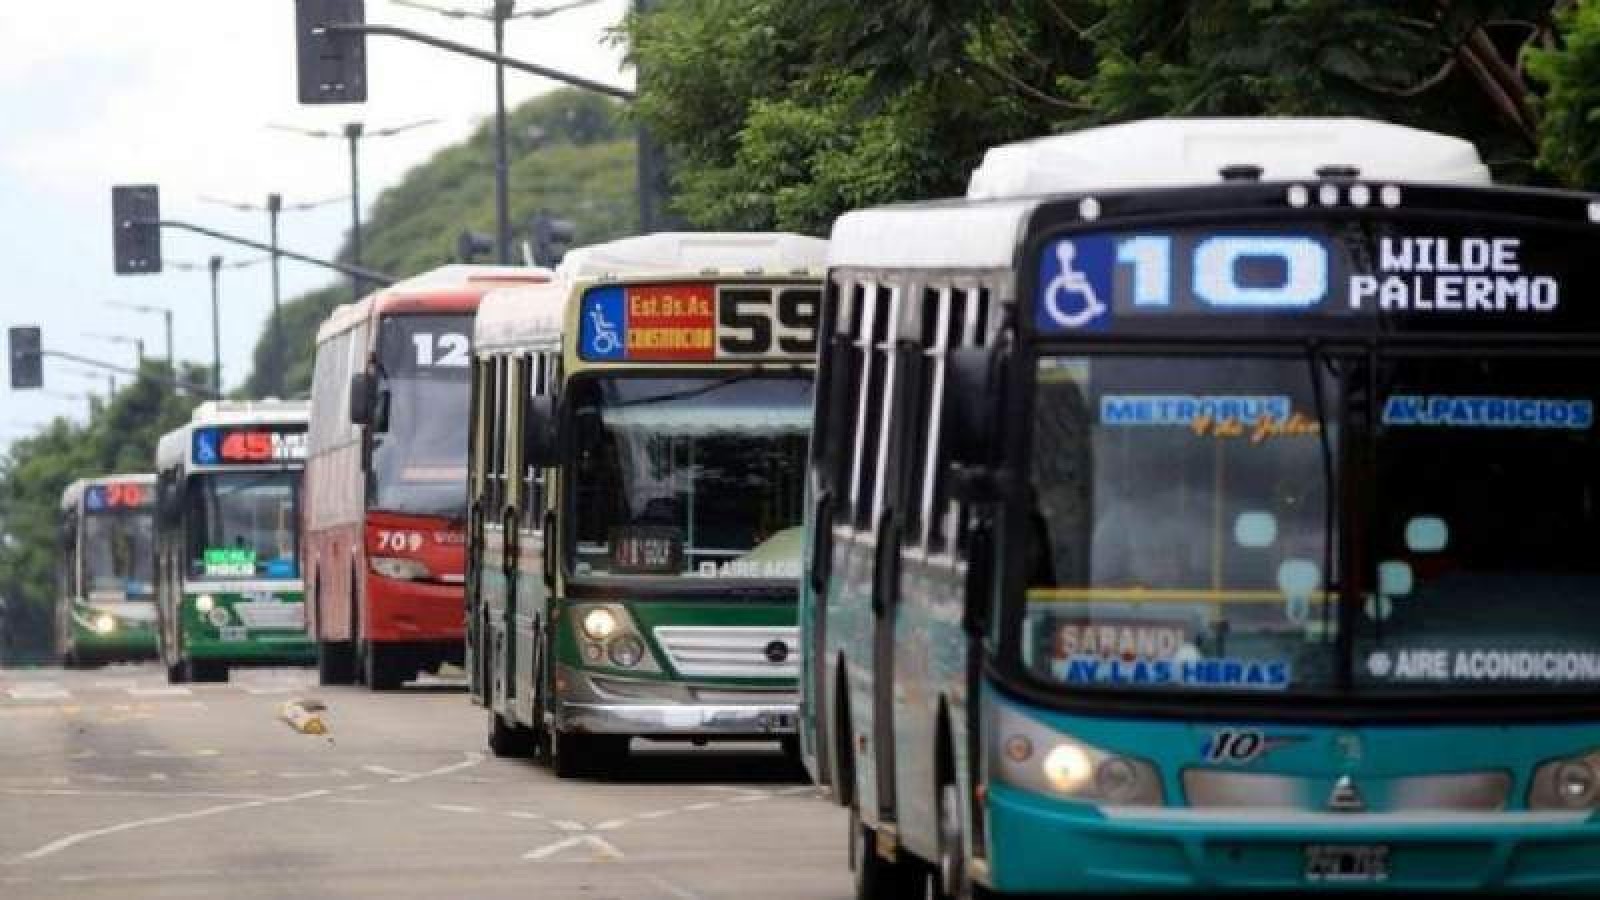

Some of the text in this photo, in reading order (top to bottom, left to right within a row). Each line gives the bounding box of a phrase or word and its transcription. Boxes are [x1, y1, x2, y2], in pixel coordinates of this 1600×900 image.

[1117, 236, 1328, 306] 10
[1380, 238, 1520, 272] WILDE
[1349, 275, 1558, 310] PALERMO
[718, 290, 821, 352] 59
[222, 431, 272, 458] 45
[377, 530, 423, 552] 709
[1396, 650, 1449, 679] AIRE
